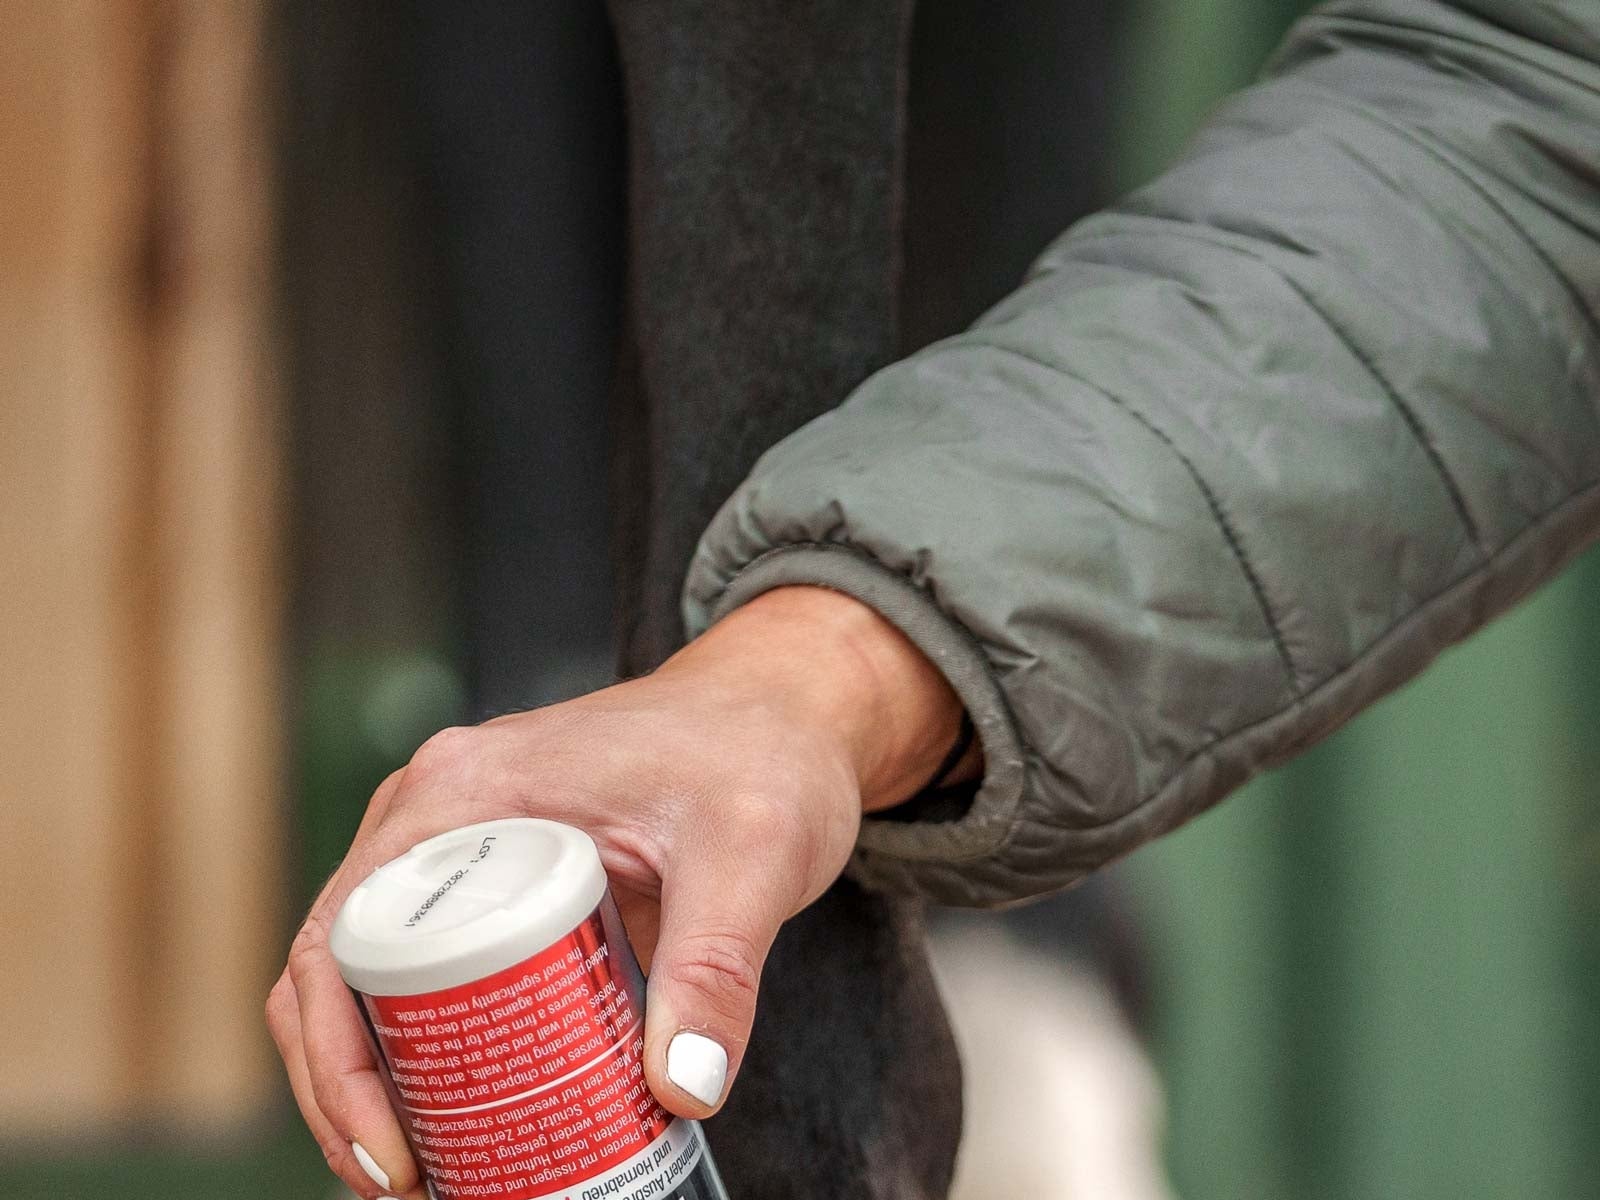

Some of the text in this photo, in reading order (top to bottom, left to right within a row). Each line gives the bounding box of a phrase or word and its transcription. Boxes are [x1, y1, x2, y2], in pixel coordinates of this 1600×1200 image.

[584, 941, 608, 971] Added
[393, 947, 583, 1023] the hoof significantly more durable.
[534, 962, 585, 1001] protection
[547, 983, 589, 1014] Secures
[616, 989, 629, 1007] low
[489, 996, 533, 1022] against
[562, 1005, 587, 1029] Hoof
[427, 1023, 459, 1035] decay
[461, 1013, 490, 1032] hoof
[511, 1013, 537, 1030] firm
[614, 1008, 633, 1031] Ideal
[402, 1027, 423, 1038] and
[464, 1033, 482, 1046] for
[483, 1024, 510, 1042] seat
[537, 1020, 561, 1041] wall
[603, 1023, 616, 1040] for
[411, 1041, 441, 1053] shoe.
[442, 1039, 463, 1051] the
[484, 1041, 510, 1058] sole
[512, 1033, 534, 1051] and
[534, 1022, 590, 1059] separating
[567, 1035, 604, 1062] horses
[463, 1051, 483, 1062] are
[505, 1053, 533, 1072] hoof
[541, 1056, 566, 1074] with
[604, 1051, 632, 1078] Macht
[427, 1075, 443, 1086] for
[443, 1072, 465, 1087] and
[467, 1063, 504, 1080] walls,
[491, 1068, 539, 1094] chipped
[582, 1072, 602, 1090] den
[630, 1062, 642, 1081] der
[432, 1089, 467, 1103] brittle
[467, 1084, 489, 1099] and
[562, 1085, 582, 1103] Huf
[583, 1073, 630, 1106] Hufeisen.
[623, 1085, 640, 1105] und
[495, 1095, 560, 1124] wesentlich
[537, 1103, 582, 1131] Schützt
[594, 1098, 624, 1121] Sohle
[516, 1123, 536, 1136] vor
[549, 1117, 593, 1142] werden
[589, 1110, 638, 1142] Trachten,
[639, 1116, 654, 1135] bei
[423, 1128, 514, 1147] Zerfallsprozessen
[491, 1133, 548, 1161] gefestigt.
[599, 1129, 641, 1156] Pferden
[552, 1138, 589, 1159] losem
[652, 1140, 673, 1167] und
[444, 1155, 459, 1164] für
[460, 1152, 490, 1165] Sorgt
[502, 1154, 552, 1175] Hufhorn
[578, 1151, 597, 1169] mit
[462, 1169, 478, 1179] für
[478, 1167, 501, 1179] und
[529, 1161, 577, 1185] rissigen
[460, 1182, 503, 1196] spröden
[504, 1178, 528, 1193] und
